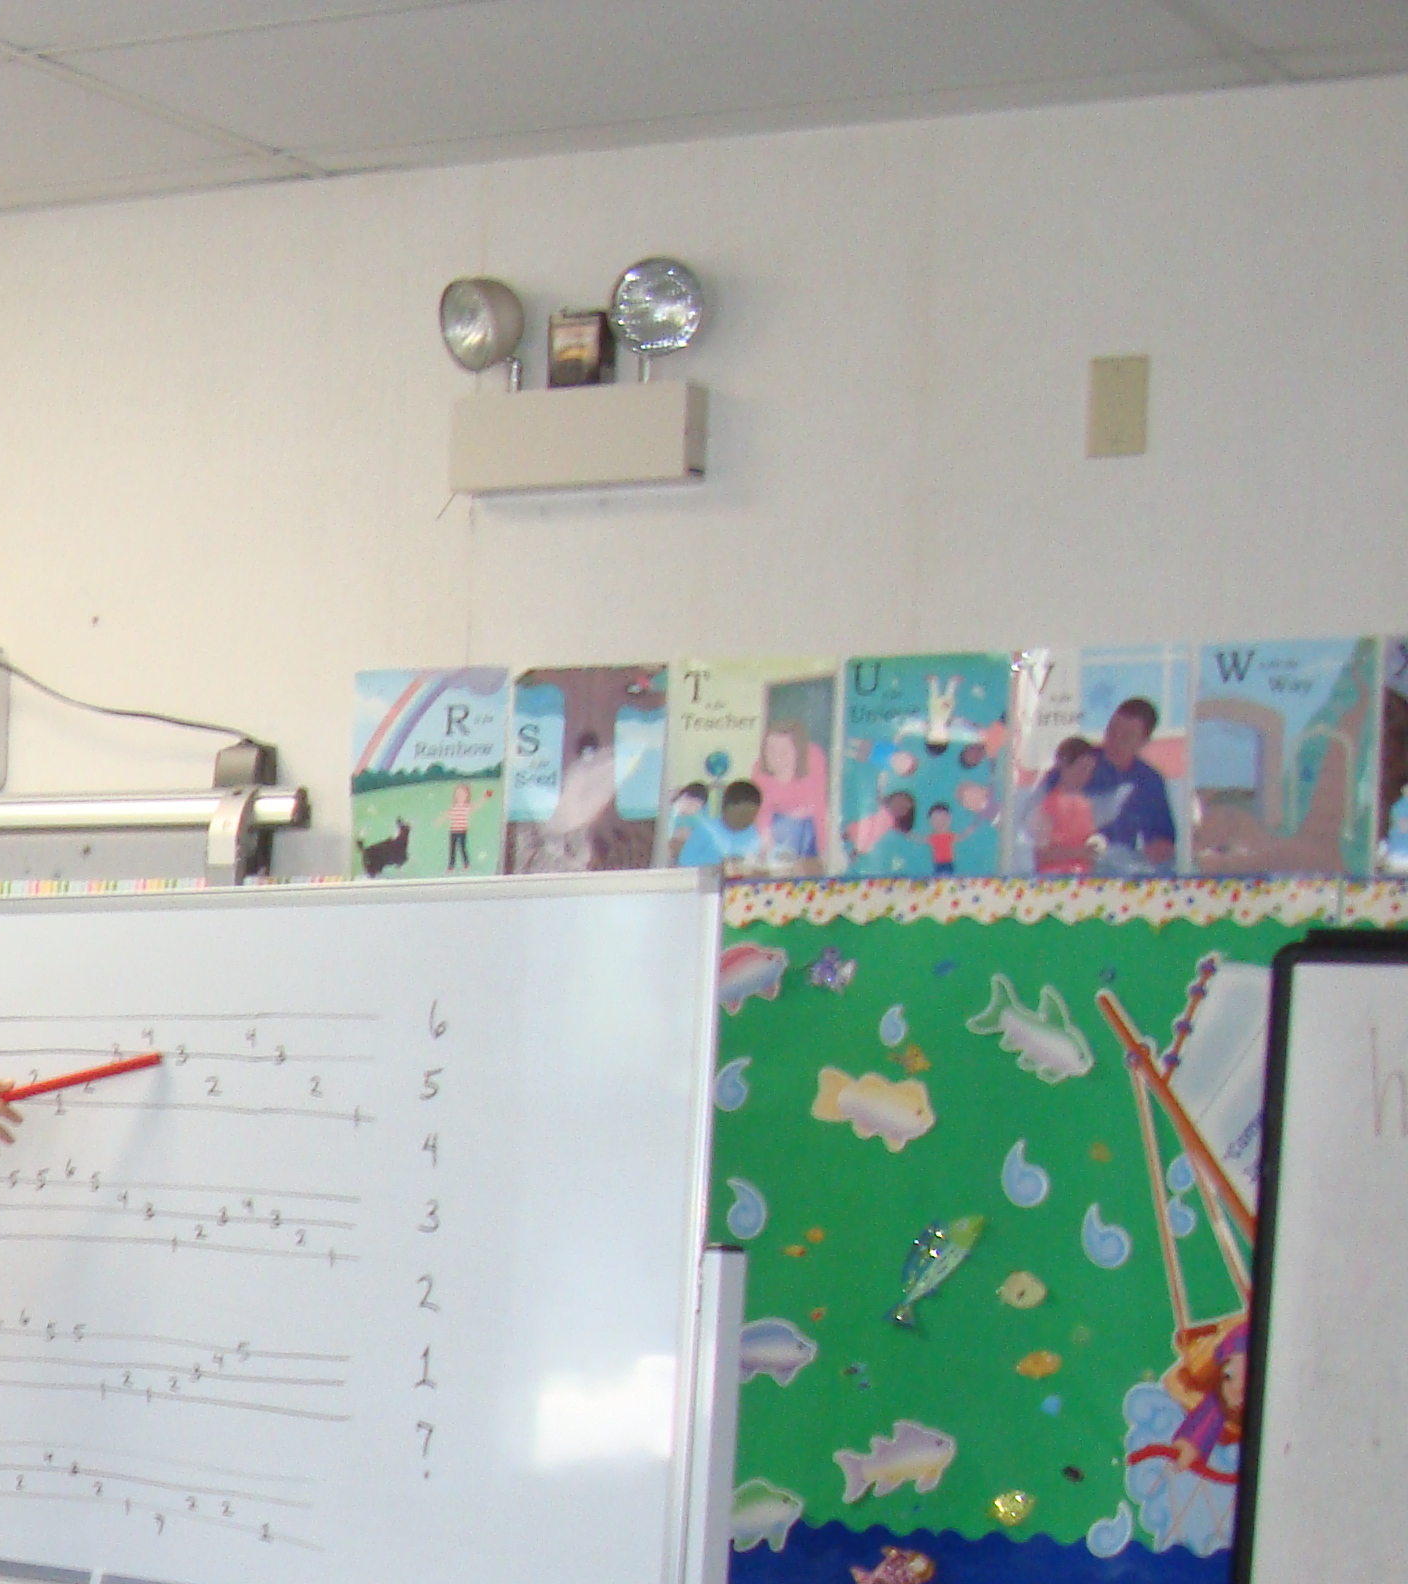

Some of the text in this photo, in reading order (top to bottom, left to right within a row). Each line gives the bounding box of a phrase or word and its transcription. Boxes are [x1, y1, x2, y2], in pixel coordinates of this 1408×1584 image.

[855, 662, 881, 695] U
[1216, 650, 1255, 683] W
[684, 670, 710, 702] T
[445, 704, 470, 737] R
[517, 724, 540, 754] S
[428, 999, 447, 1040] 6
[175, 1043, 190, 1067] 3
[205, 1074, 224, 1098] 2
[310, 1074, 324, 1099] 2
[419, 1066, 446, 1101] 5
[422, 1132, 439, 1169] 4
[64, 1158, 77, 1178] 6
[193, 1223, 208, 1241] 2
[418, 1198, 441, 1233] 3
[417, 1273, 441, 1312] 2
[19, 1308, 31, 1327] 6
[414, 1344, 437, 1389] 1
[221, 1499, 236, 1518] 2
